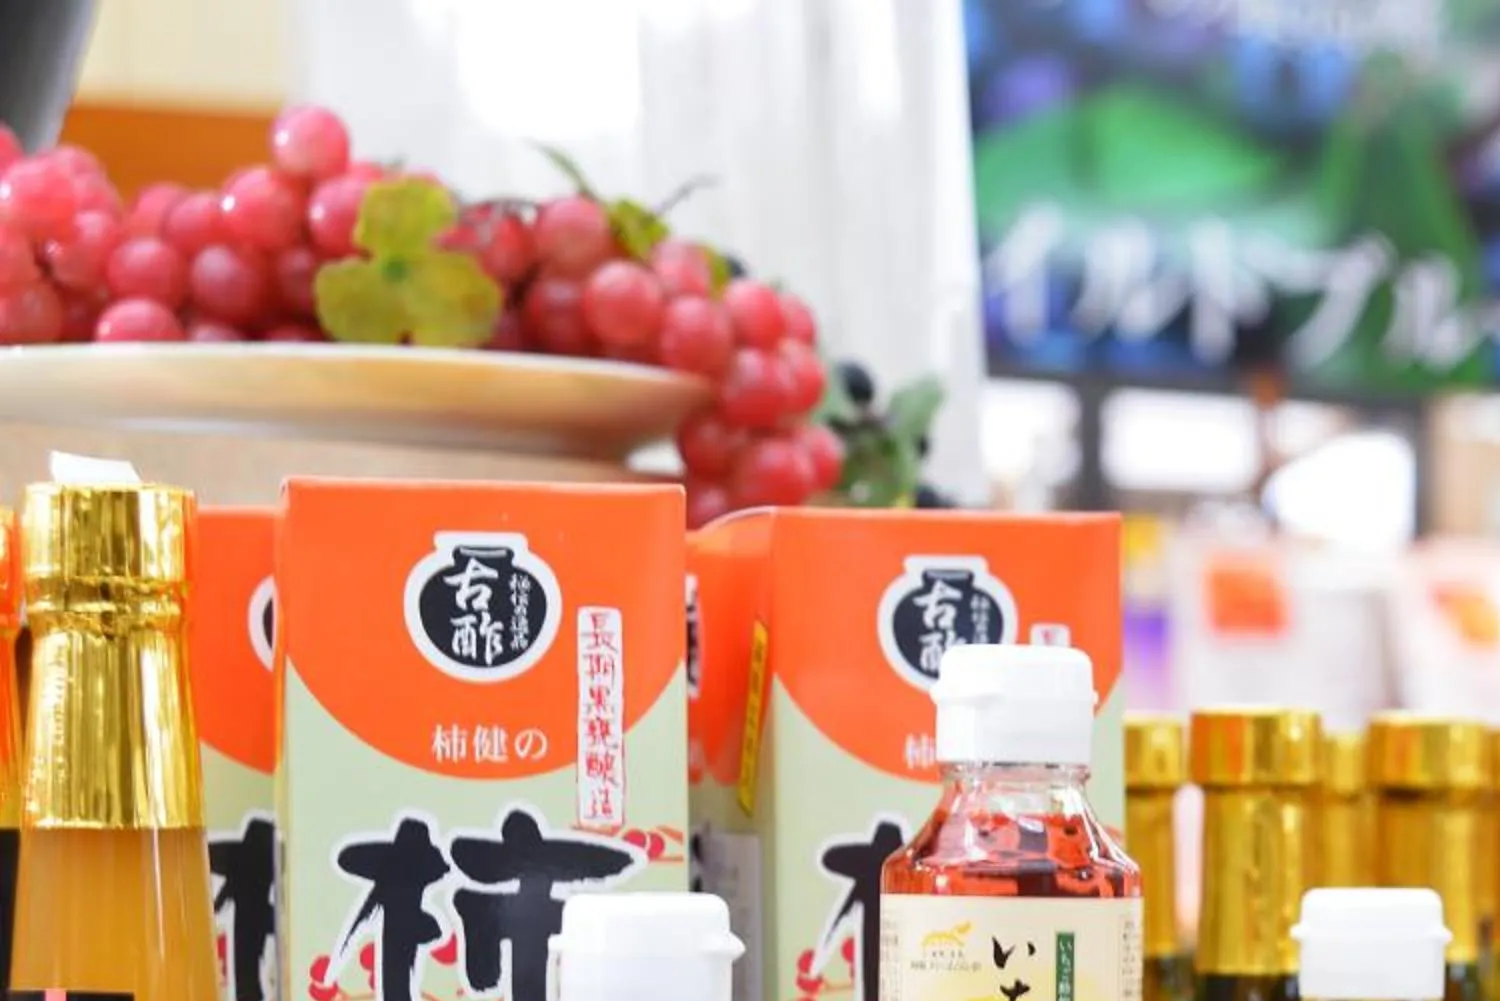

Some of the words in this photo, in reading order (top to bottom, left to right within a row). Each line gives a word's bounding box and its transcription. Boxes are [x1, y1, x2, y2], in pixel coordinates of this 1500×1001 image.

[443, 557, 504, 666] 古酢
[431, 724, 549, 764] 柿健の
